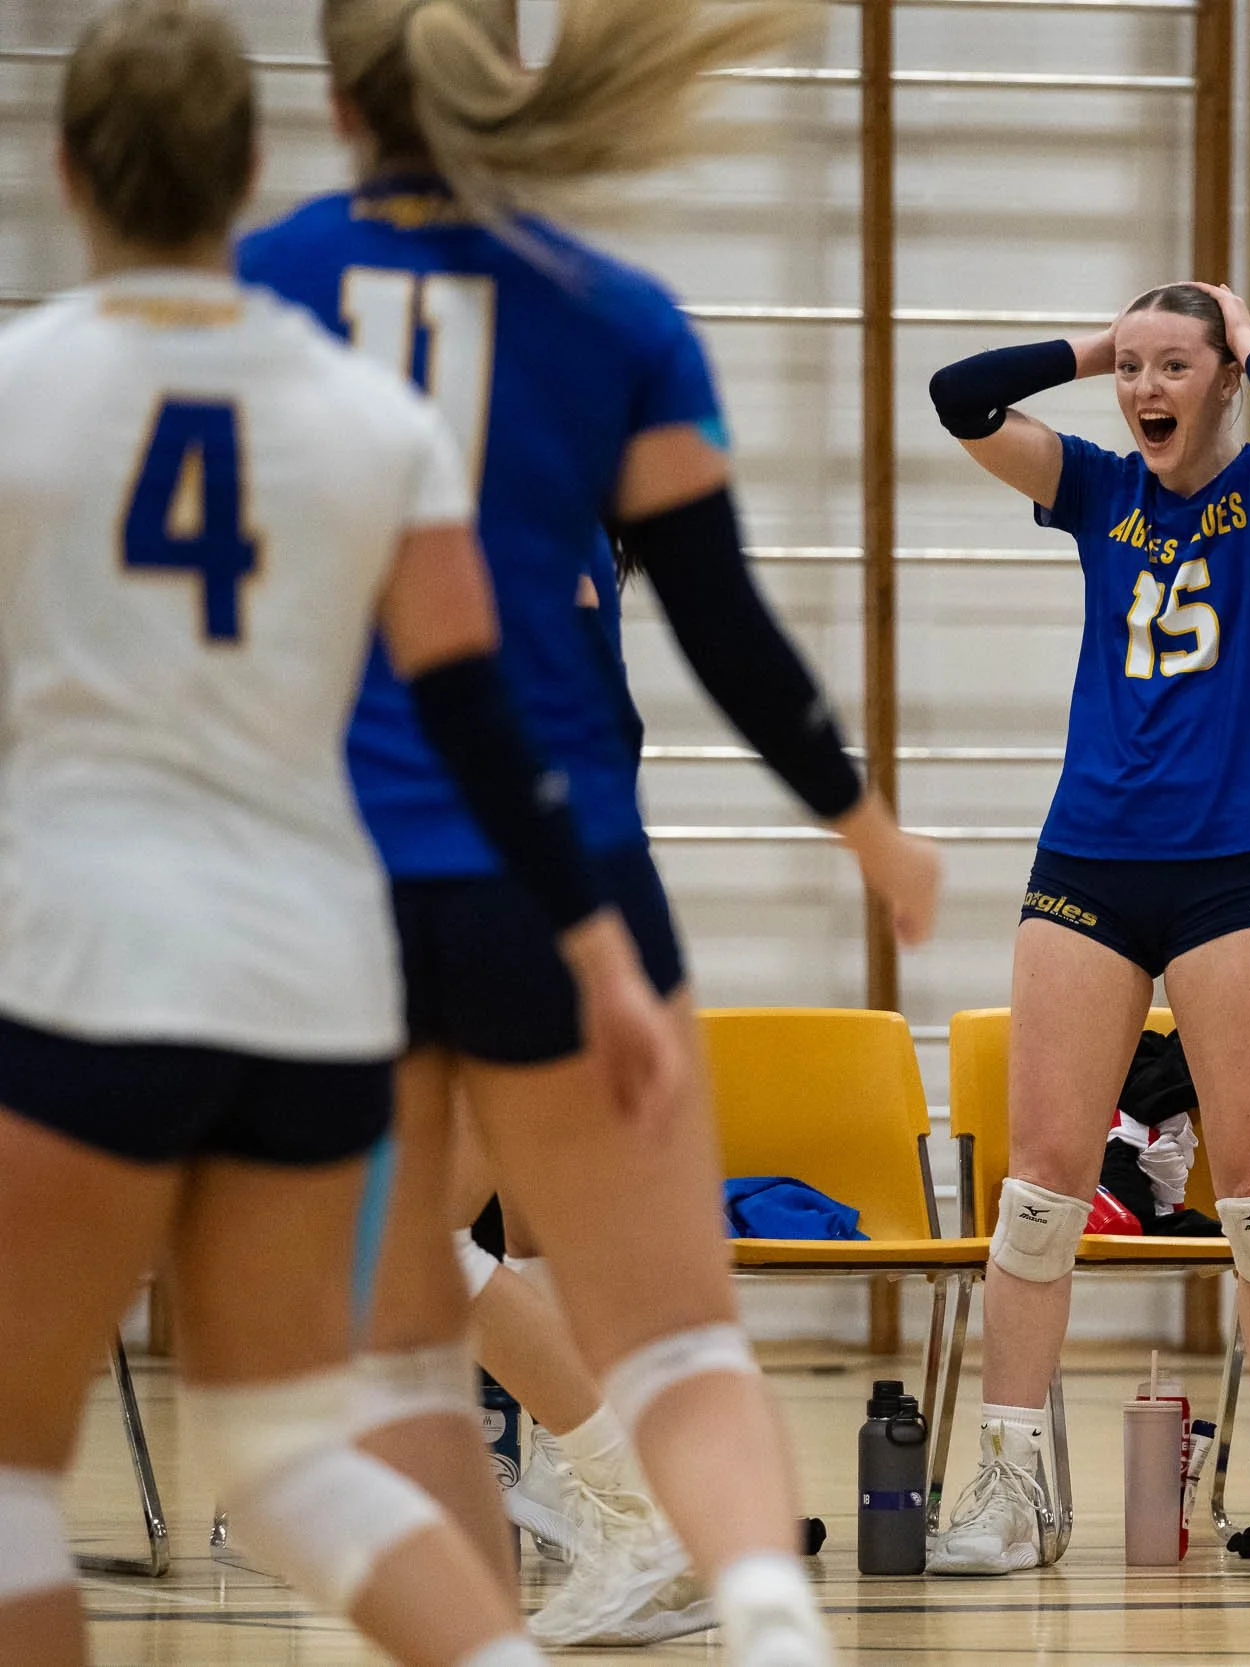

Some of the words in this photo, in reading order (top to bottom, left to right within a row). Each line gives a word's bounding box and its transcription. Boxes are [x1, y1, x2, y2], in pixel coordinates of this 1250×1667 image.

[115, 391, 266, 646] 4
[1109, 507, 1178, 564] AIGES
[1125, 557, 1220, 679] 15
[1025, 890, 1098, 927] aigles
[863, 1493, 870, 1505] 18
